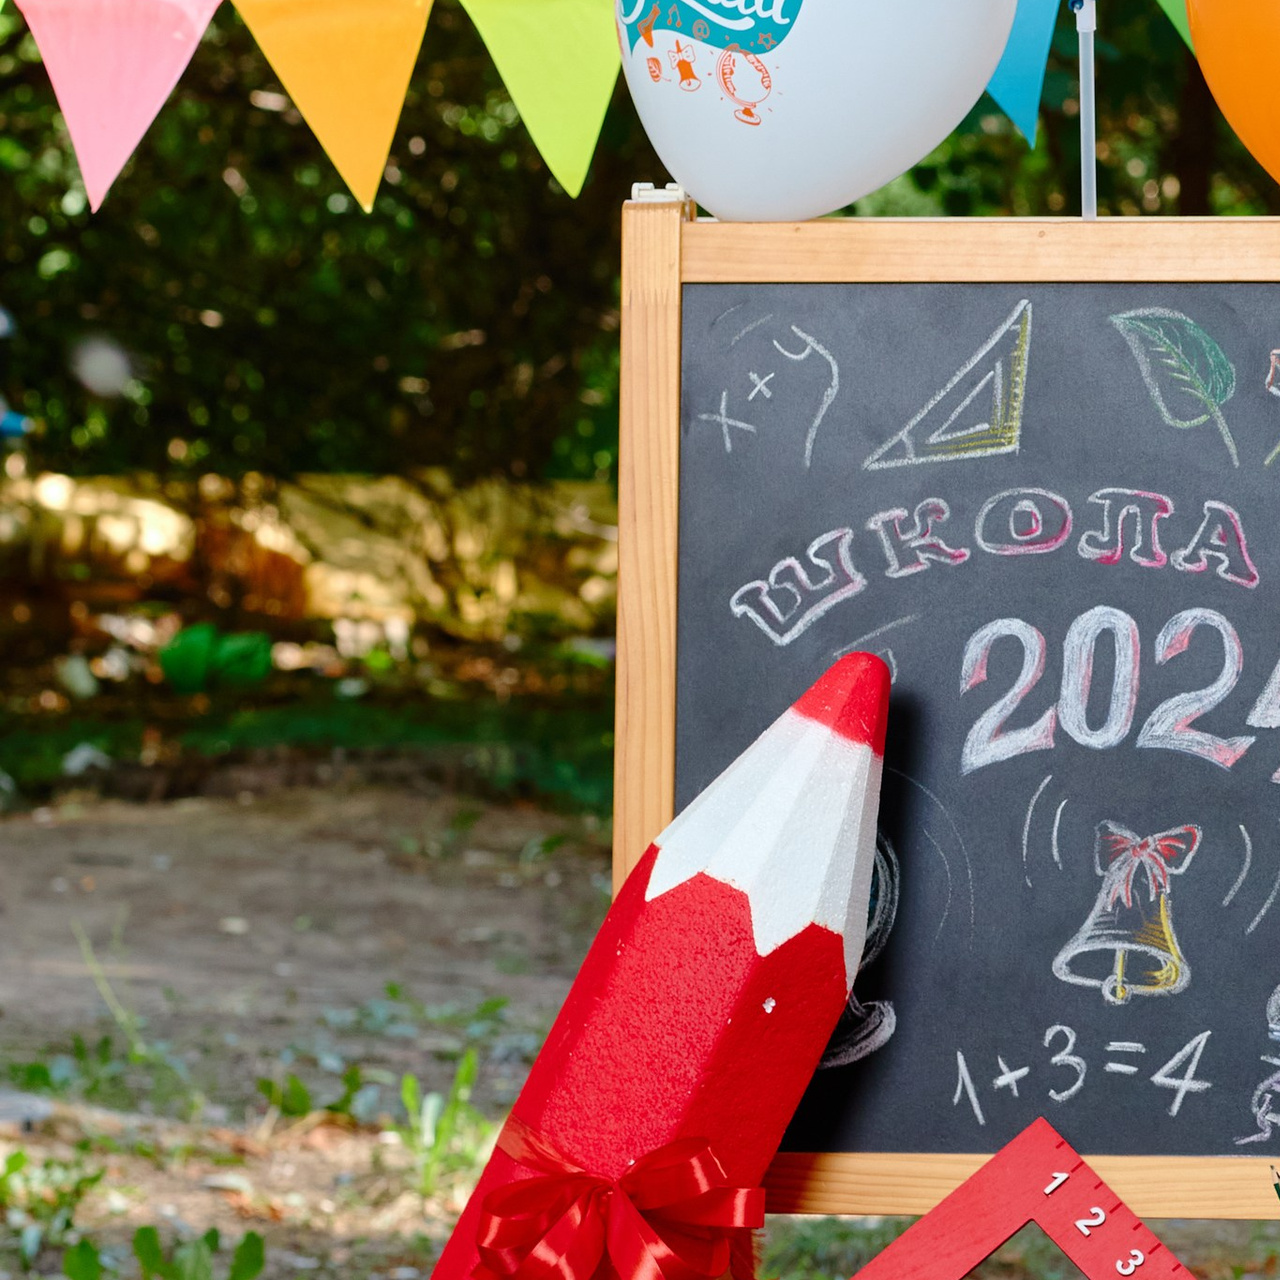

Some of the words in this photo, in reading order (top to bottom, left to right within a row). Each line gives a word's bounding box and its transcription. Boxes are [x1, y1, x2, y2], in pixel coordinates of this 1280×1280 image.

[1043, 1171, 1070, 1196] 1
[1074, 1206, 1107, 1237] 2
[1115, 1248, 1145, 1277] 3
